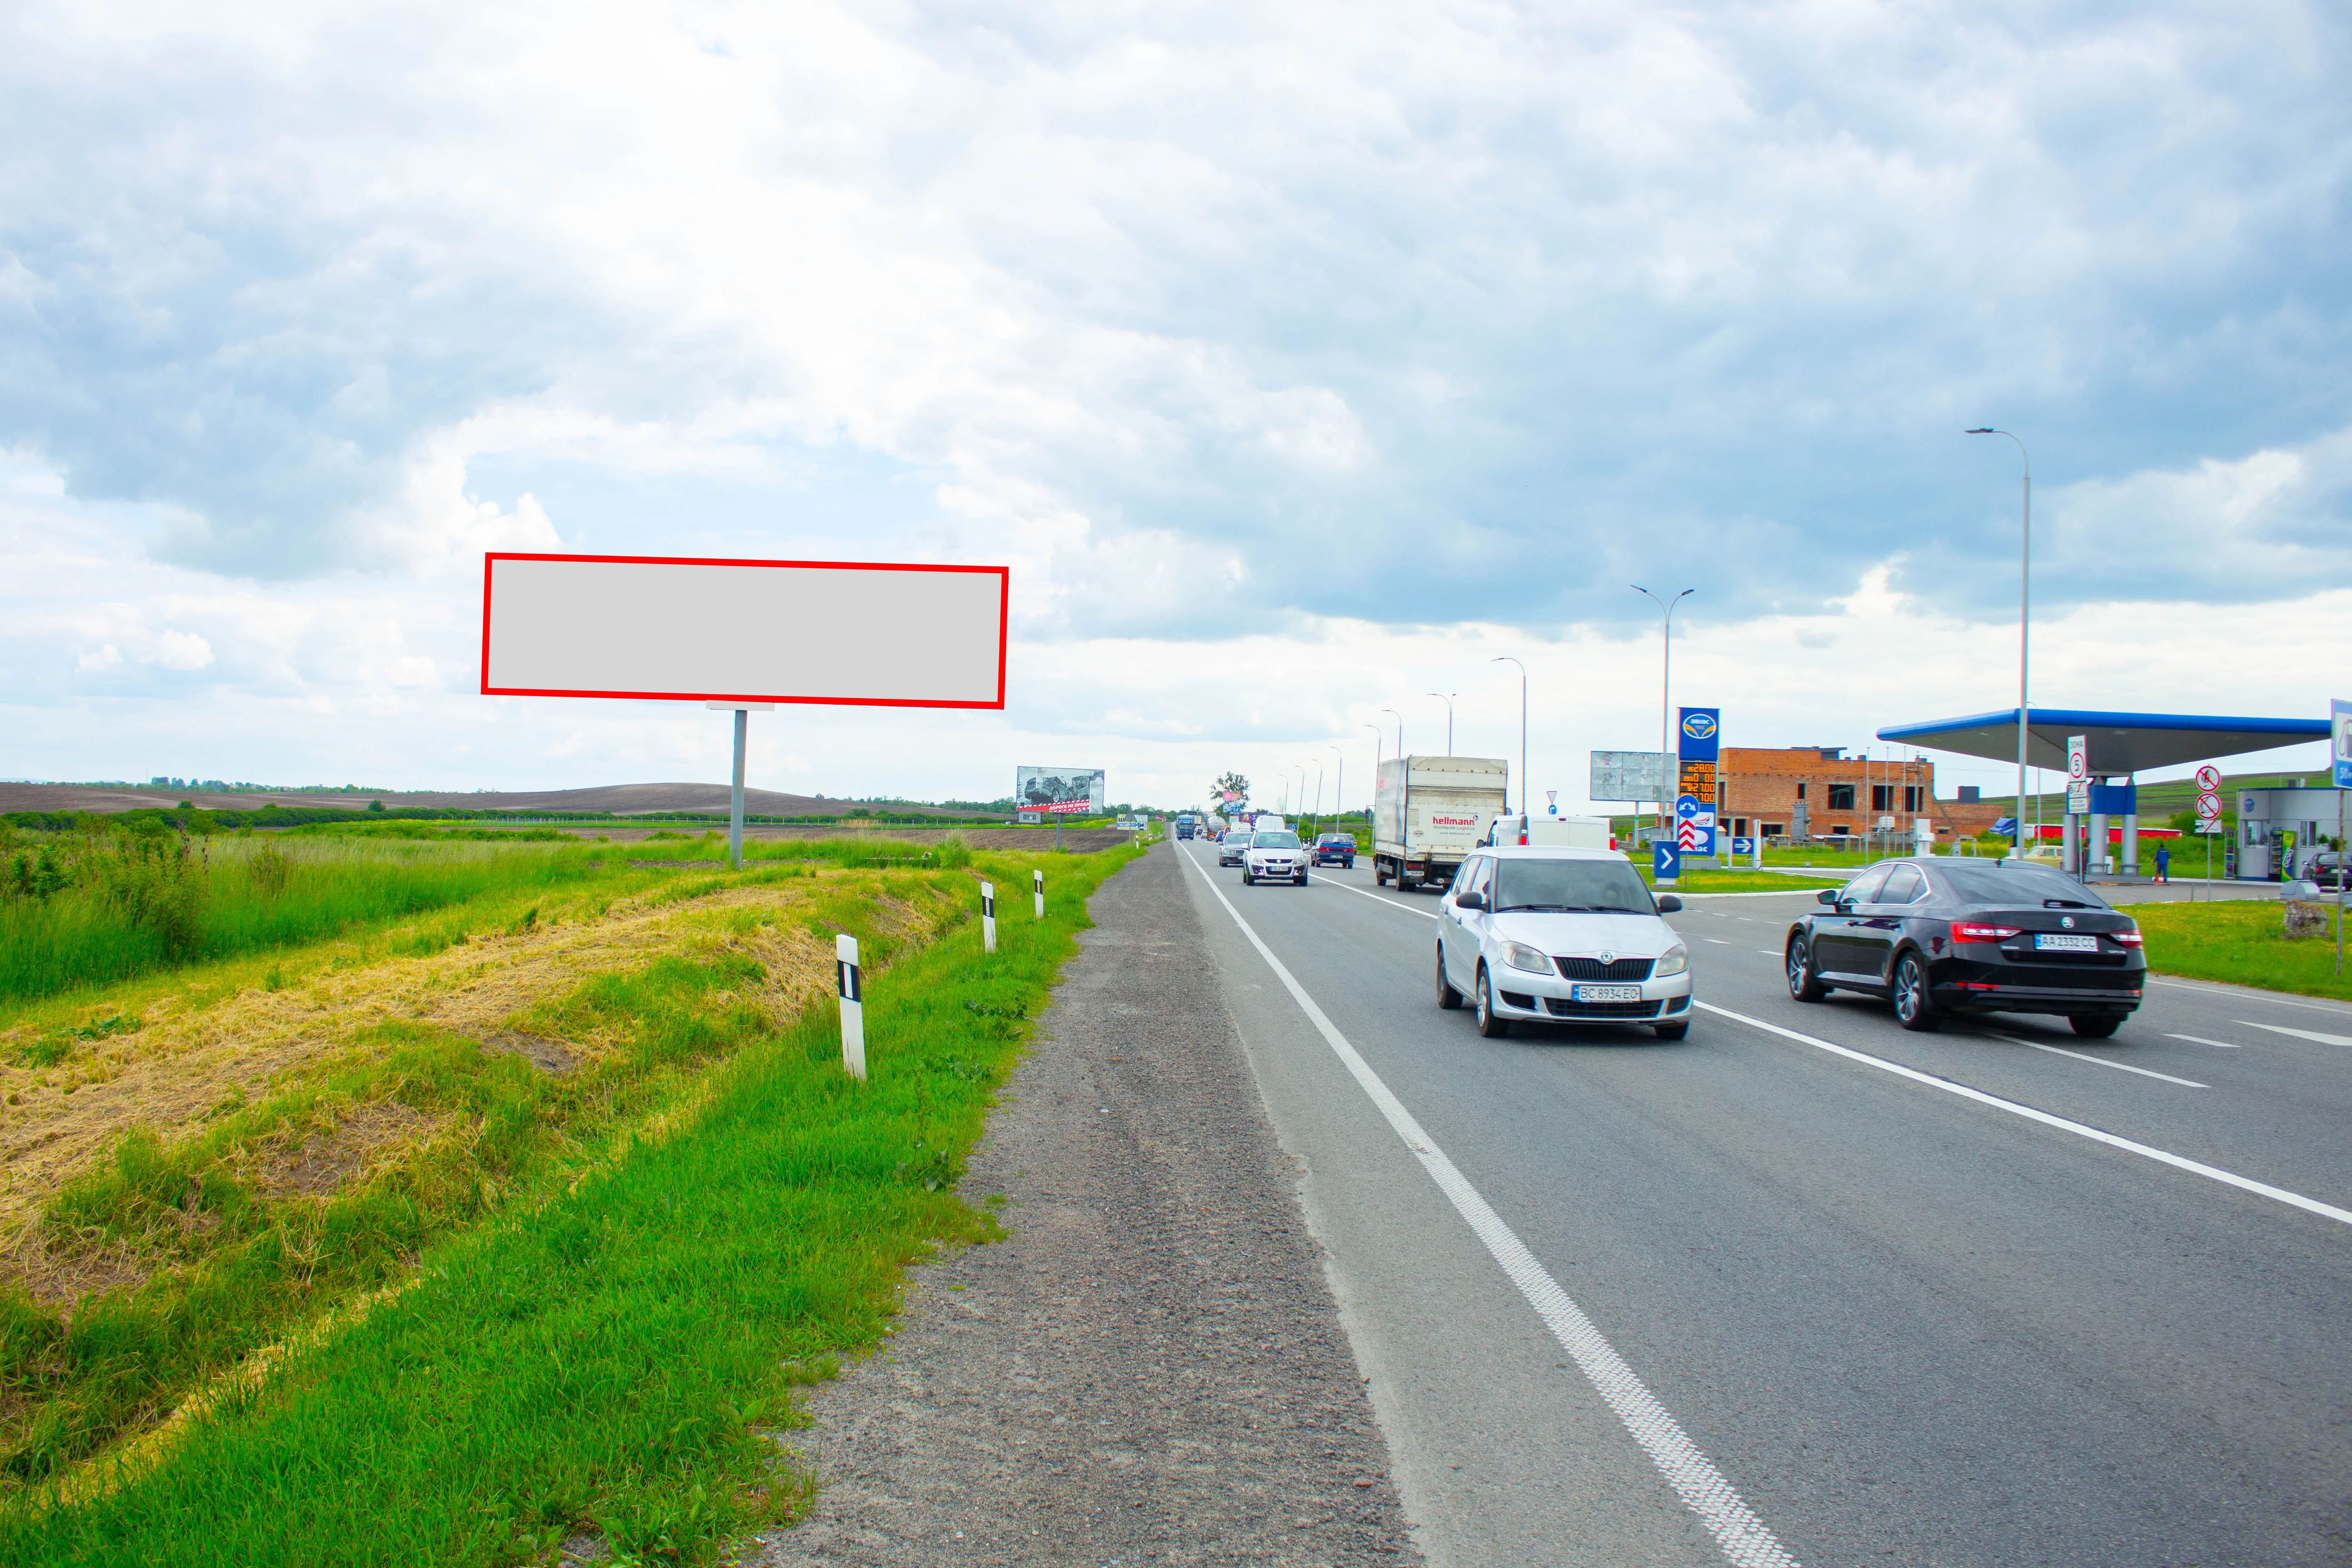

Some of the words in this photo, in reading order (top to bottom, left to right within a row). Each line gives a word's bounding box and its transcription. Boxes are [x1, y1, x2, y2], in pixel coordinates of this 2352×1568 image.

[2070, 740, 2083, 749] ЗОНА
[2075, 759, 2079, 771] 5
[1433, 816, 1475, 825] hellmann
[2042, 936, 2055, 946] AA
[2057, 937, 2080, 947] 2332
[2082, 938, 2095, 947] CC
[1581, 988, 1594, 998] BC
[1598, 988, 1621, 999] 8934
